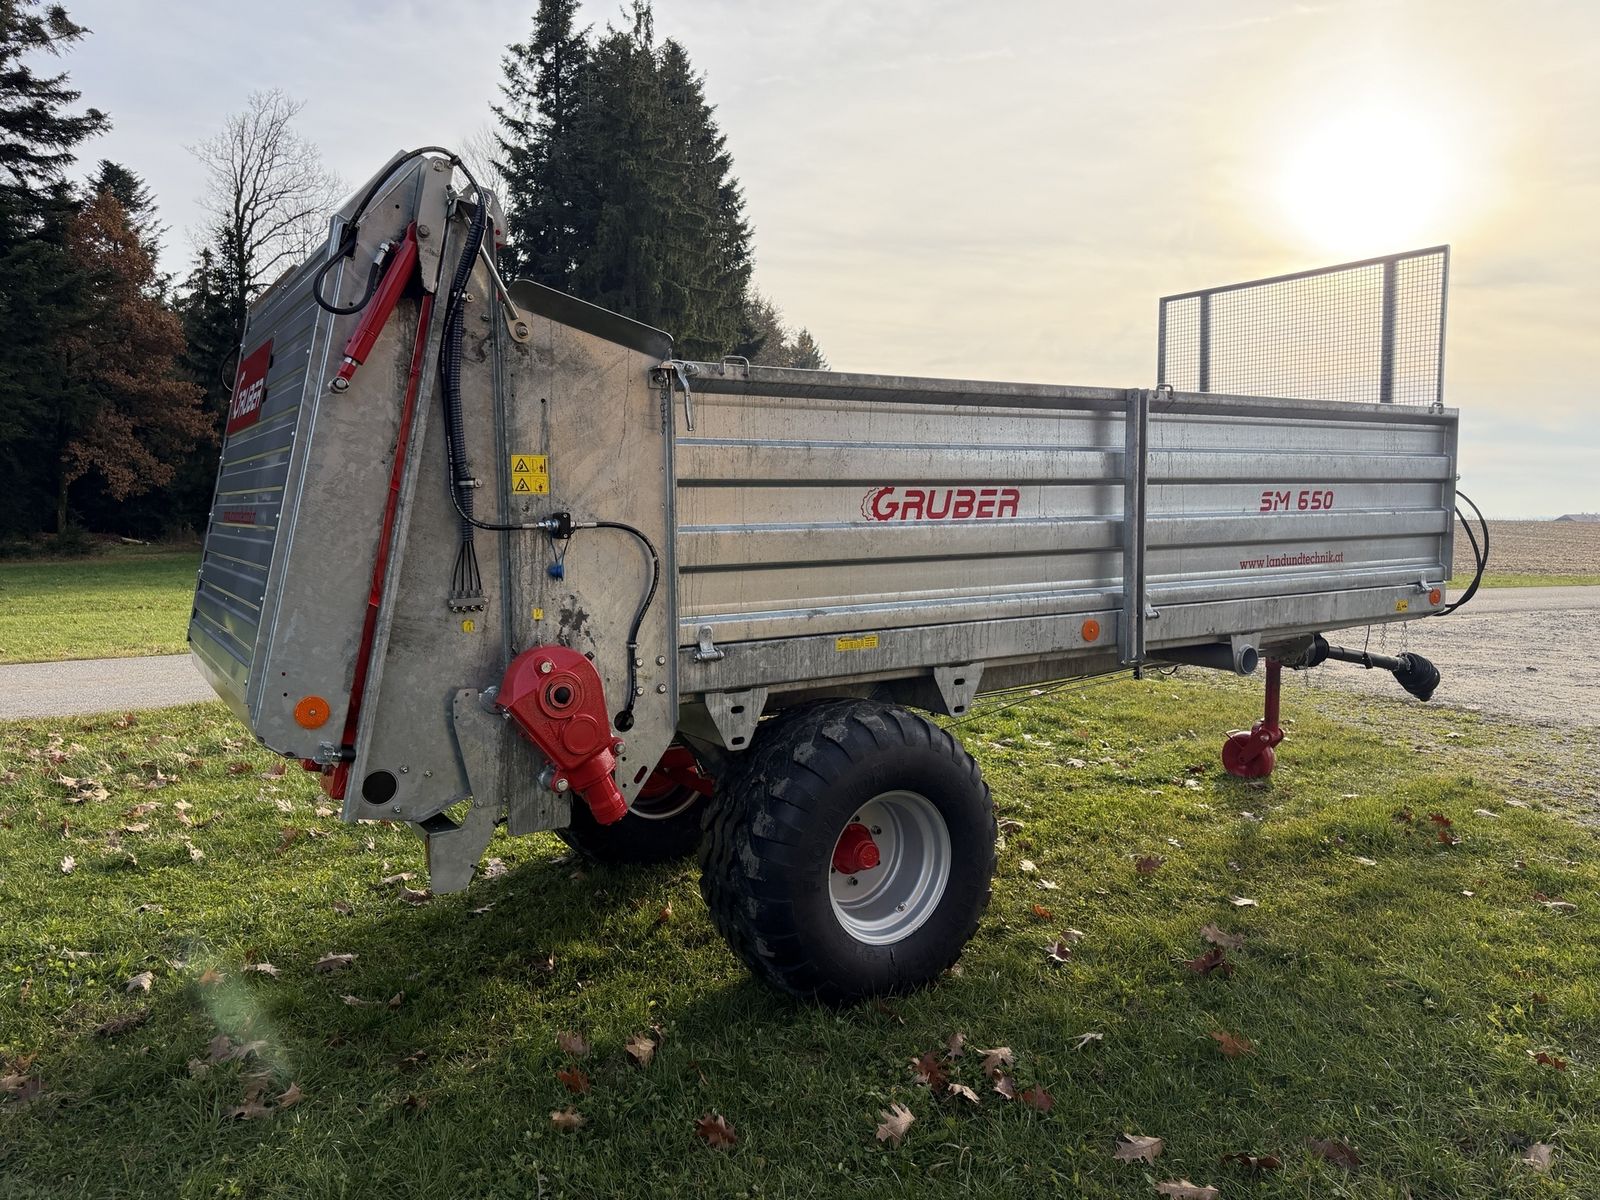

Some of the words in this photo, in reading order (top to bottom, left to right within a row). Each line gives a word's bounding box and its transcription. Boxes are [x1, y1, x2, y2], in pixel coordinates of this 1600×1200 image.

[868, 487, 1020, 521] GRUBER
[1260, 491, 1291, 511] SM
[1297, 490, 1334, 510] 650
[1239, 550, 1344, 570] www.landundtechnik.at
